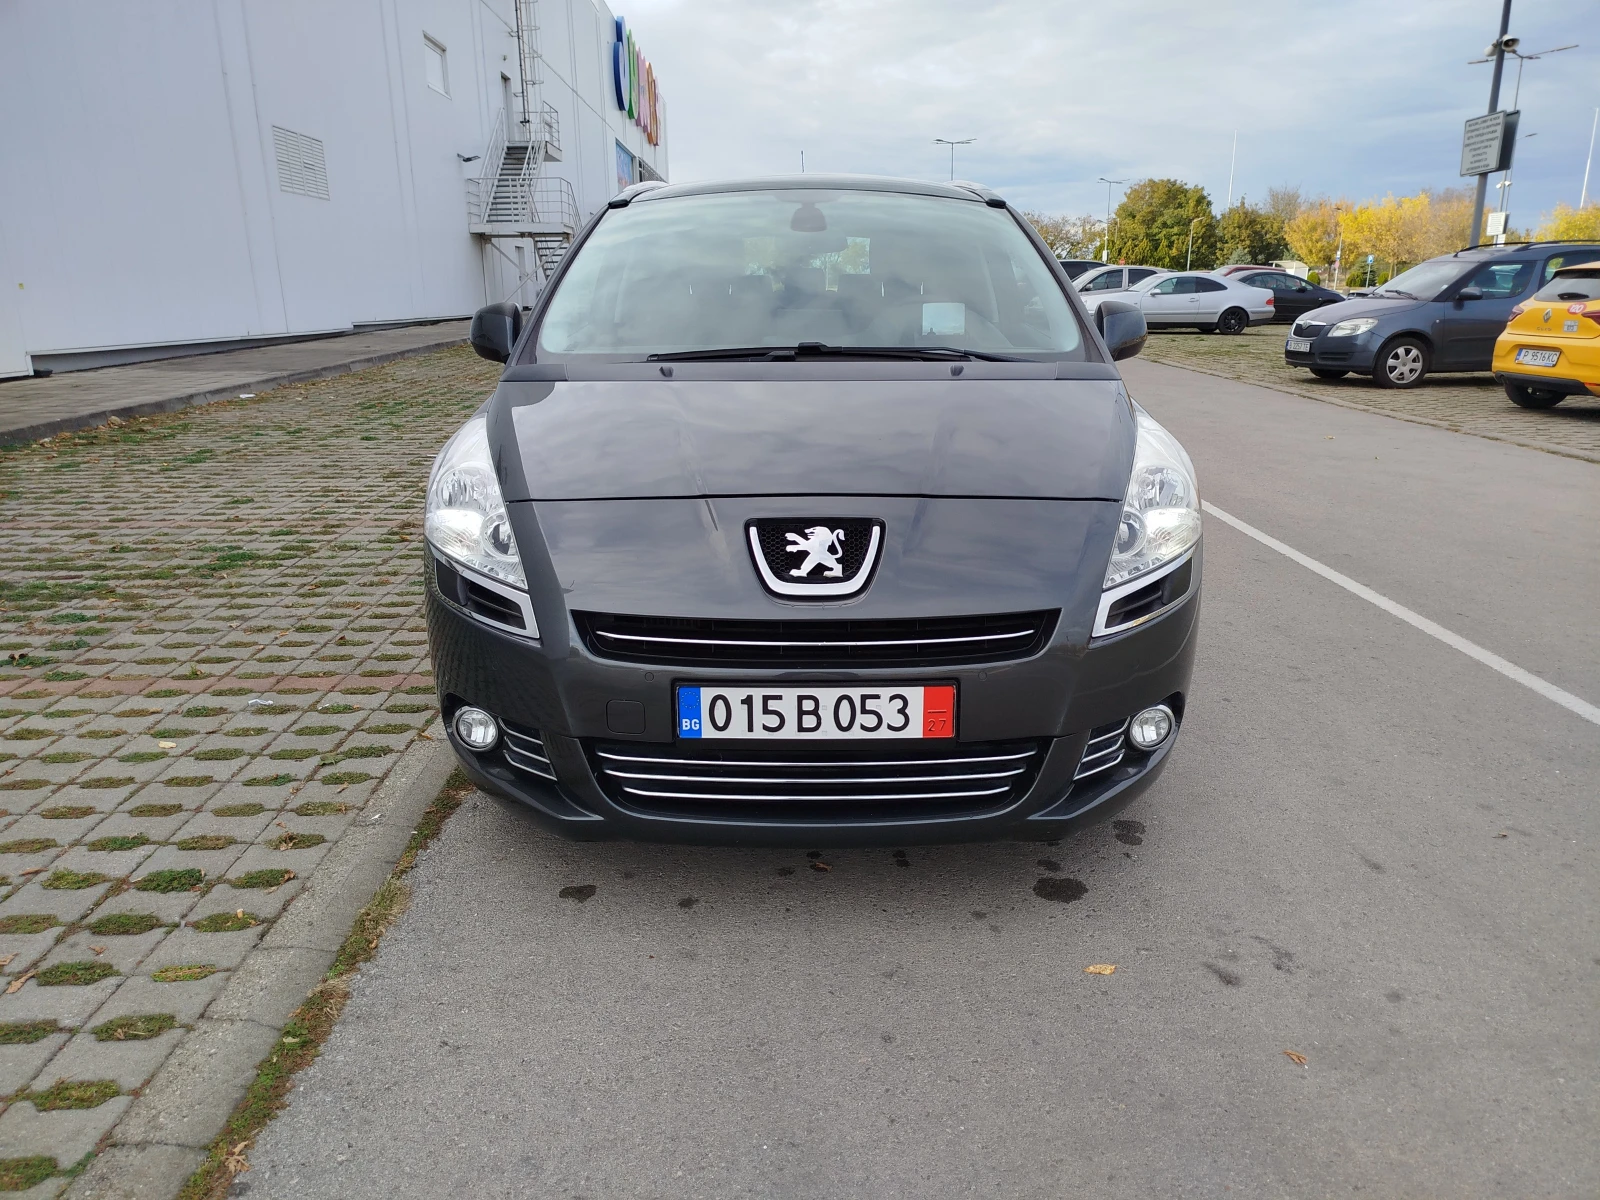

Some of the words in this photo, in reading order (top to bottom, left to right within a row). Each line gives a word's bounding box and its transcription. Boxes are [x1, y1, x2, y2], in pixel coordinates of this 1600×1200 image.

[1569, 304, 1584, 313] 120
[1522, 350, 1529, 360] P
[708, 694, 786, 733] 015
[796, 694, 822, 733] B
[833, 694, 911, 733] 053
[682, 718, 700, 731] BG
[927, 718, 947, 732] 27
